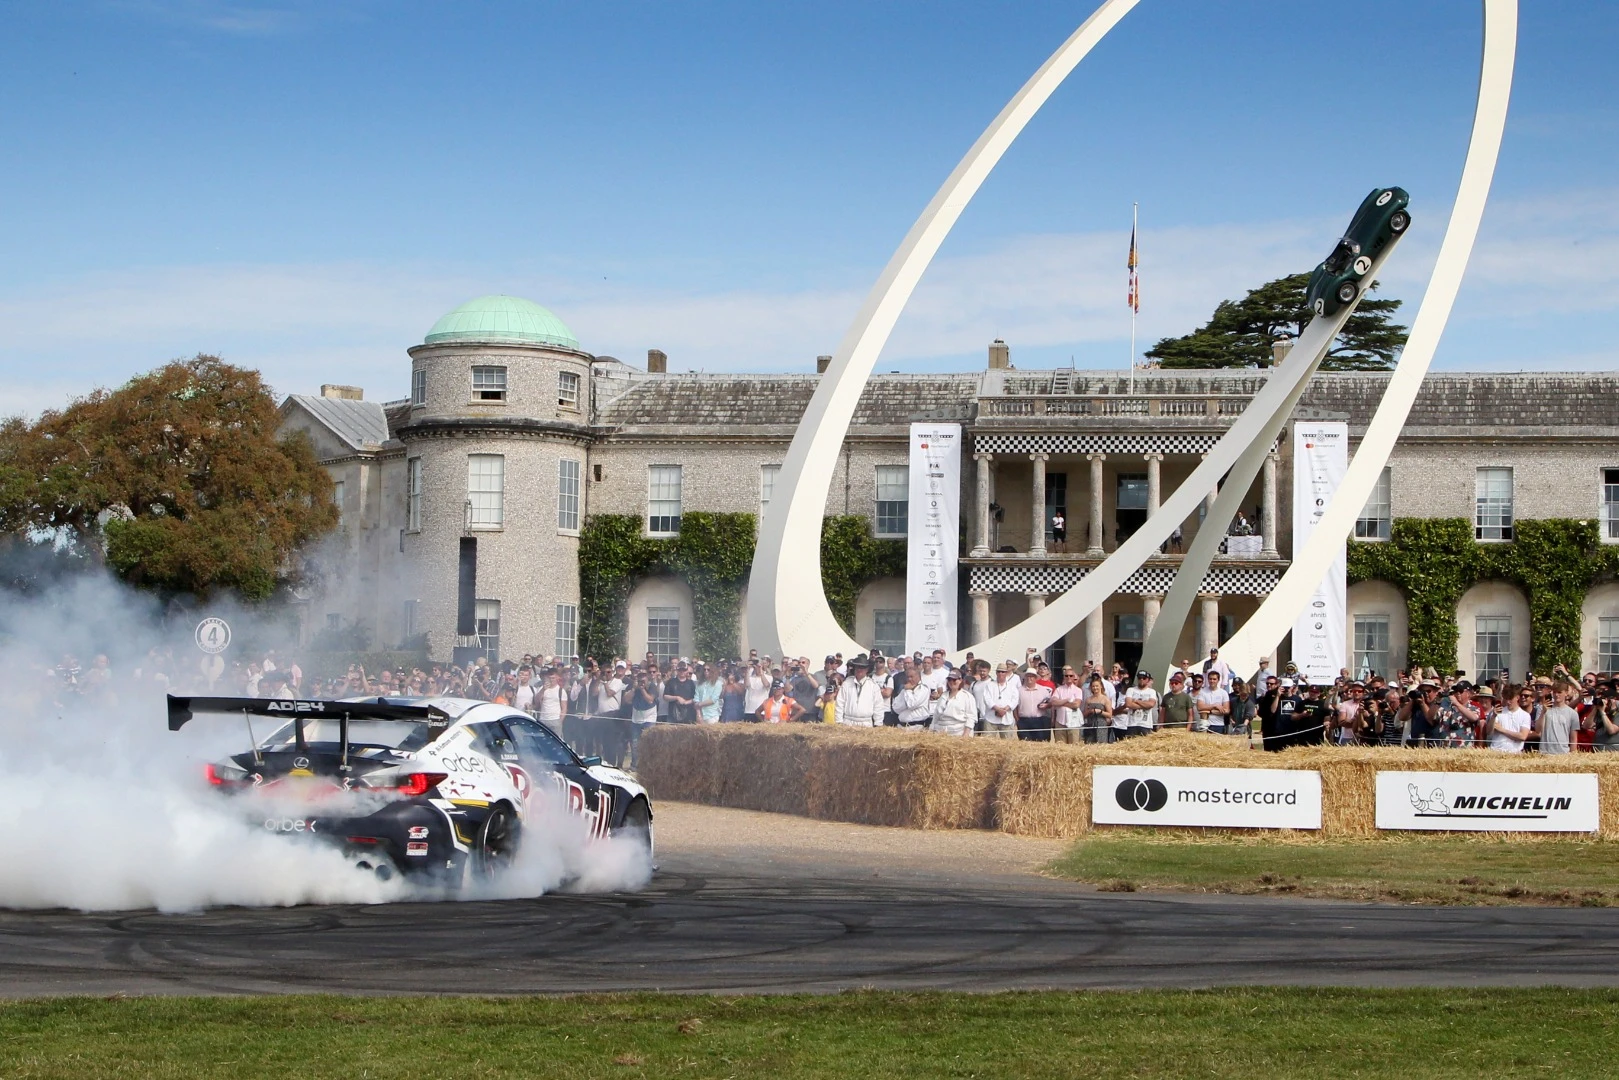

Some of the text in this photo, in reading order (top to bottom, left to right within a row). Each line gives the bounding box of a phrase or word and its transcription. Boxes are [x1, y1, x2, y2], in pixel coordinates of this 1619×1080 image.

[1356, 259, 1370, 272] 2
[1317, 300, 1323, 315] 2
[207, 626, 218, 645] 4
[442, 753, 493, 773] orbex
[1178, 788, 1296, 805] mastercard
[1453, 796, 1572, 810] MICHELIN
[264, 816, 316, 833] orbex
